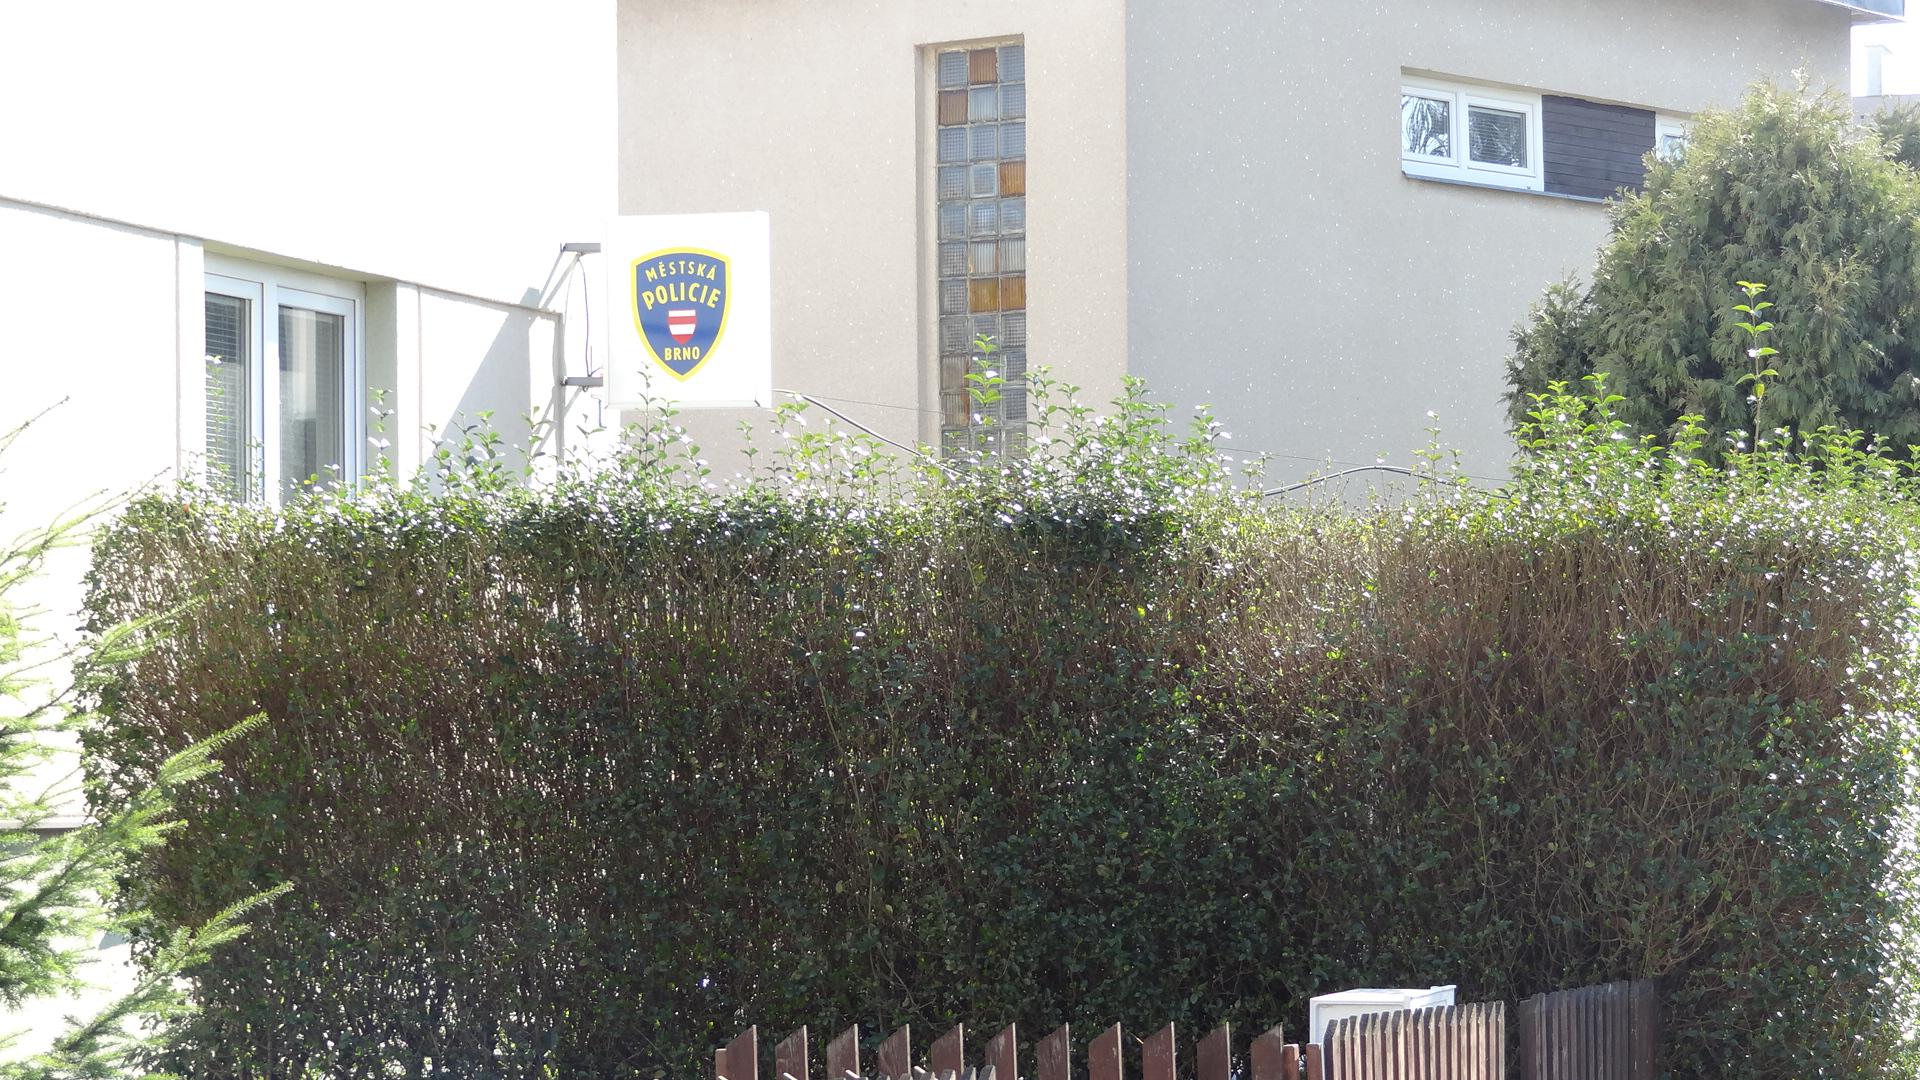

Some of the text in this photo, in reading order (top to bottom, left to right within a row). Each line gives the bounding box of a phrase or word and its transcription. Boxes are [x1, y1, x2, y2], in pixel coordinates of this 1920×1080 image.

[645, 261, 717, 282] MĚSTSKÁ
[642, 282, 721, 310] POLICIE
[664, 346, 700, 360] BRNO
